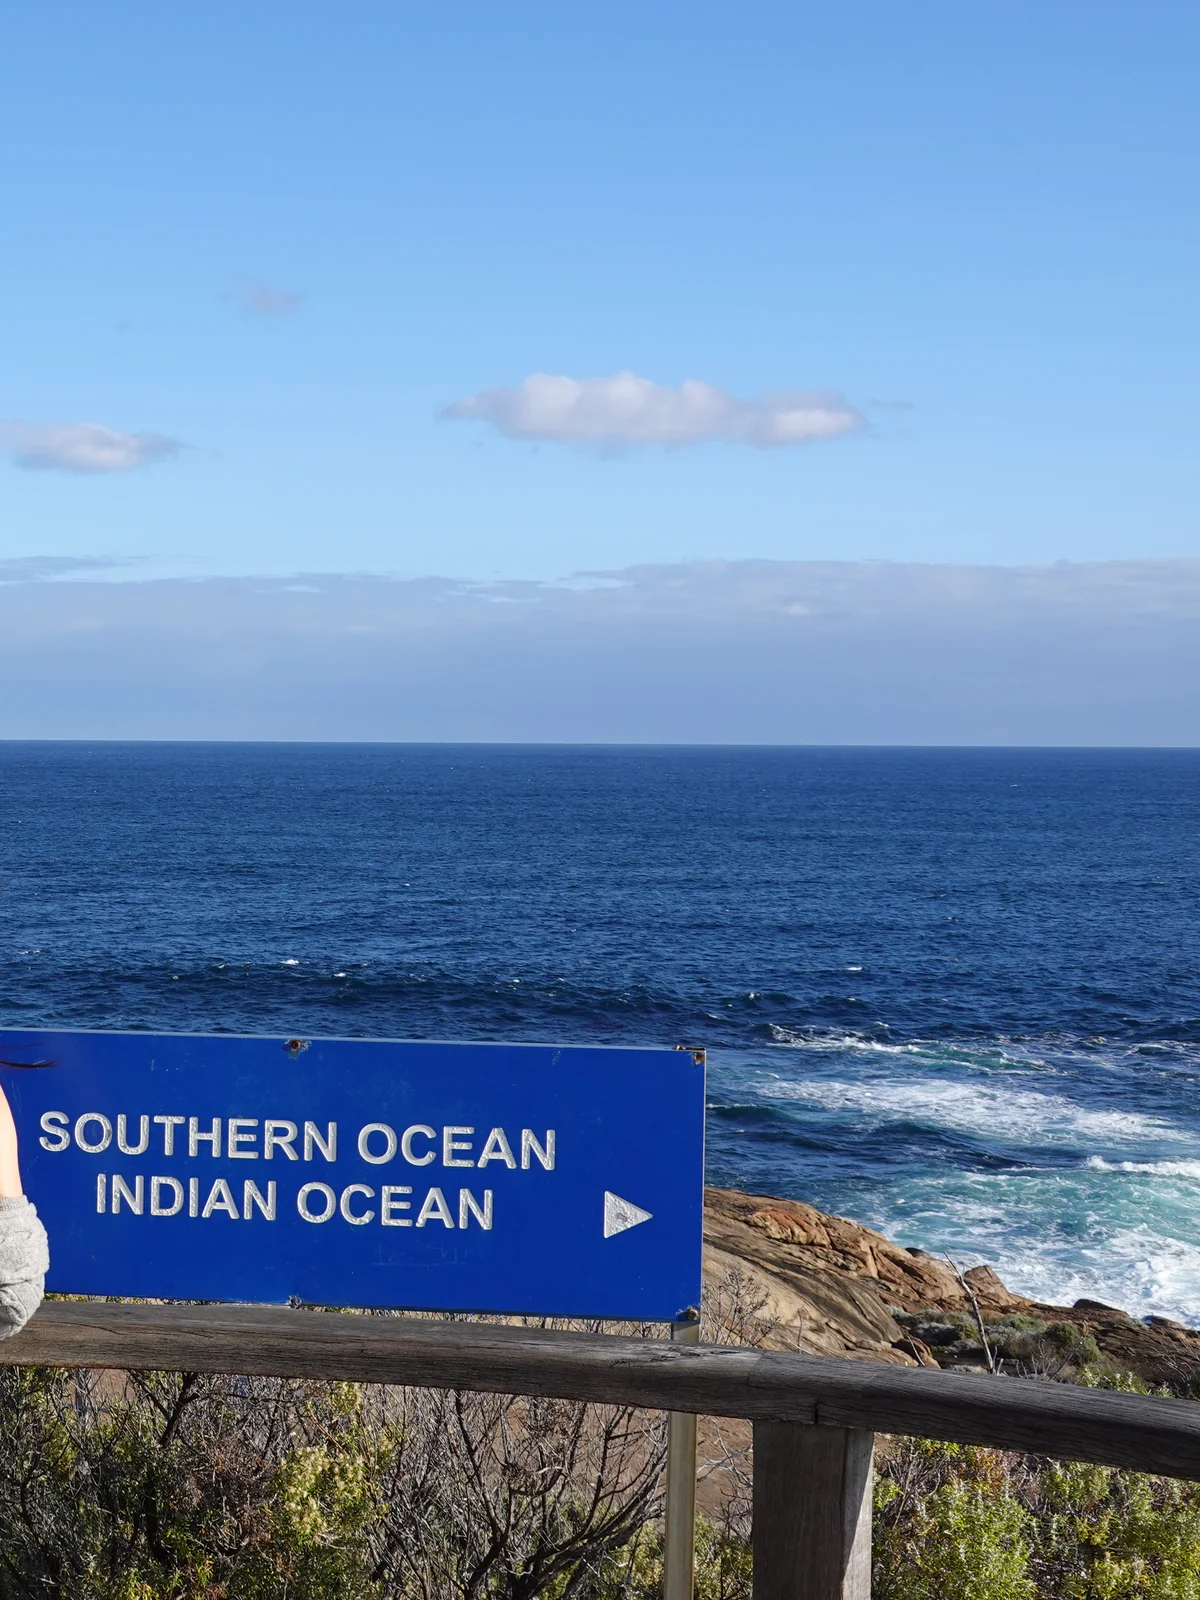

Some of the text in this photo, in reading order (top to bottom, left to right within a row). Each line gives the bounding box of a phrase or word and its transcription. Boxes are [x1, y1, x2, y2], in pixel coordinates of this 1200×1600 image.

[39, 1111, 556, 1171] SOUTHERN OCEAN
[96, 1173, 493, 1231] INDIAN OCEAN
